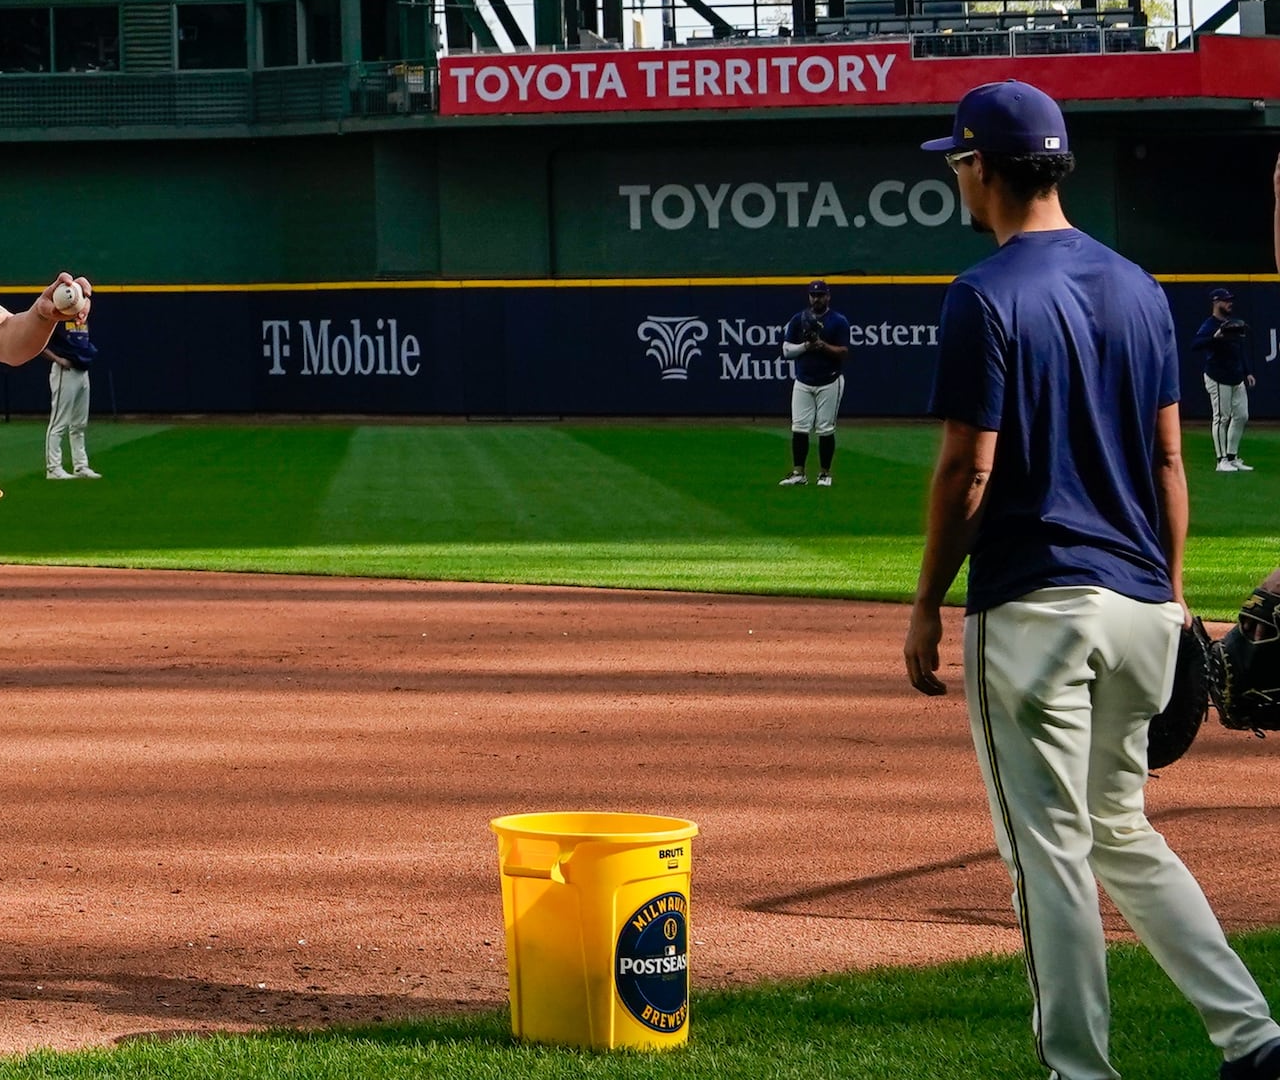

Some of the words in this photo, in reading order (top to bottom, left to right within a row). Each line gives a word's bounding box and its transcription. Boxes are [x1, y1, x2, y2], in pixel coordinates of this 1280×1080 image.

[450, 62, 627, 103] TOYOTA
[638, 53, 897, 98] TERRITORY
[618, 179, 972, 230] TOYOTA.CO
[299, 318, 421, 376] Mobile
[658, 847, 684, 859] BRUTE
[620, 955, 687, 975] POSTSEAS
